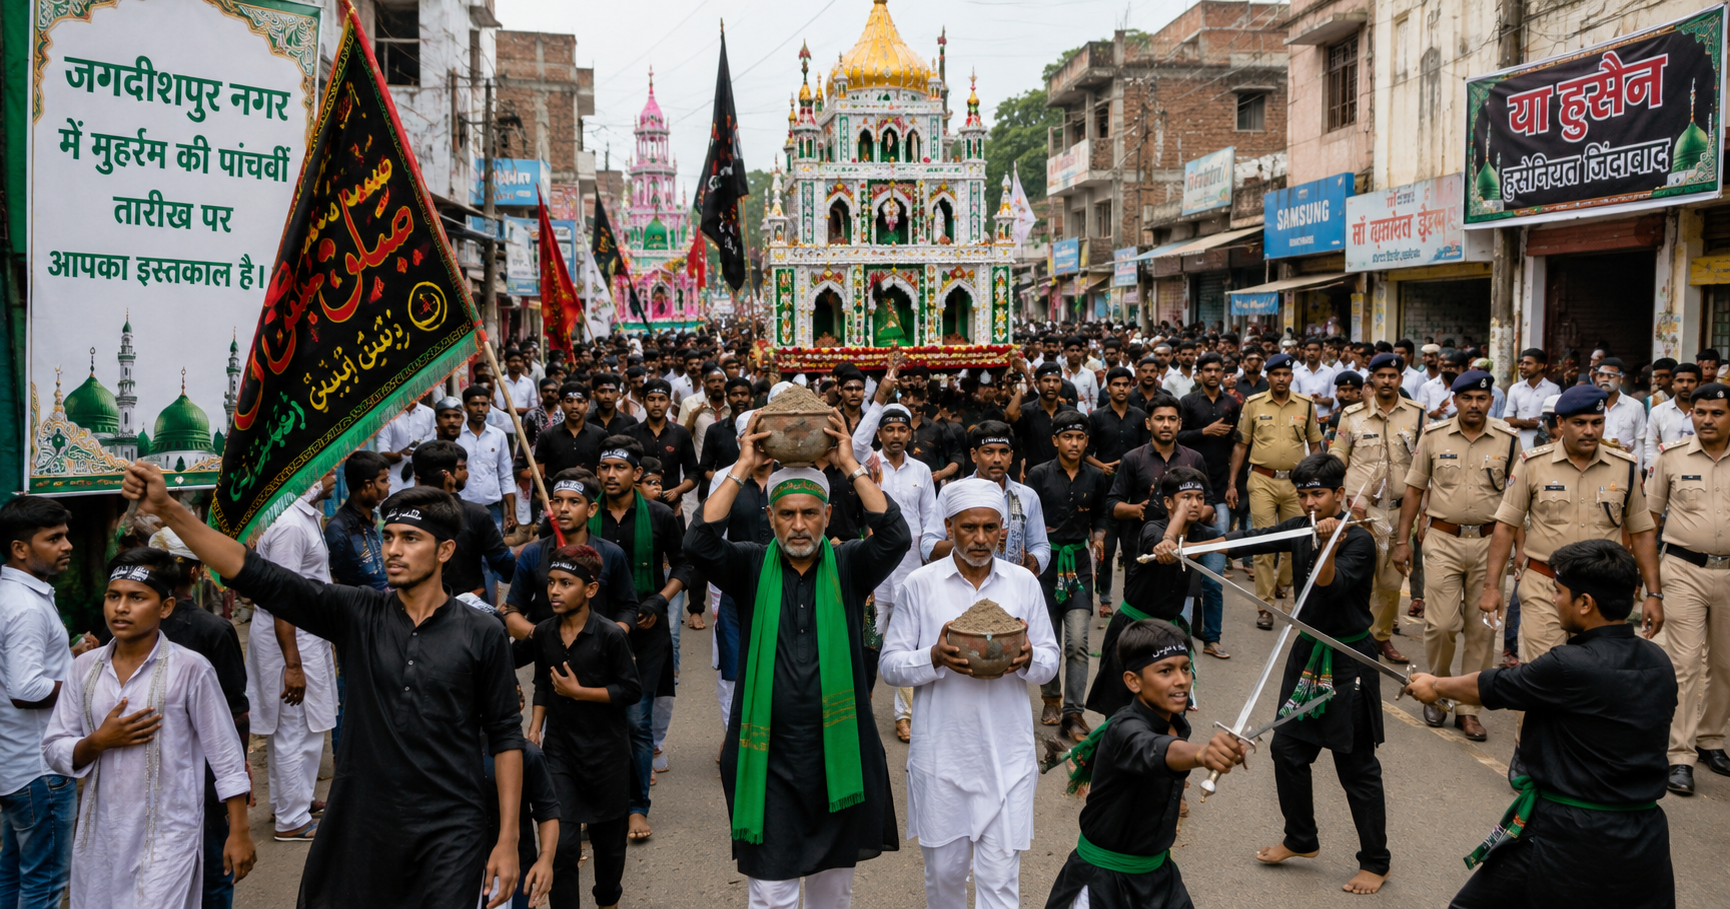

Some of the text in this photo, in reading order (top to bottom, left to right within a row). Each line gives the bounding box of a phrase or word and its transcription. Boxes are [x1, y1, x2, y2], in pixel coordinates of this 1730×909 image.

[64, 55, 291, 123] जगदीशपुर नगर
[1507, 50, 1669, 143] या हुसैन
[58, 117, 84, 160] में
[90, 128, 168, 175] मुहर्रम
[175, 134, 212, 174] की
[1584, 139, 1672, 183] जिंदाबाद
[112, 189, 234, 233] तारीख पर
[1277, 199, 1330, 231] SAMSUNG
[48, 250, 265, 290] आपका इस्तकाल है।
